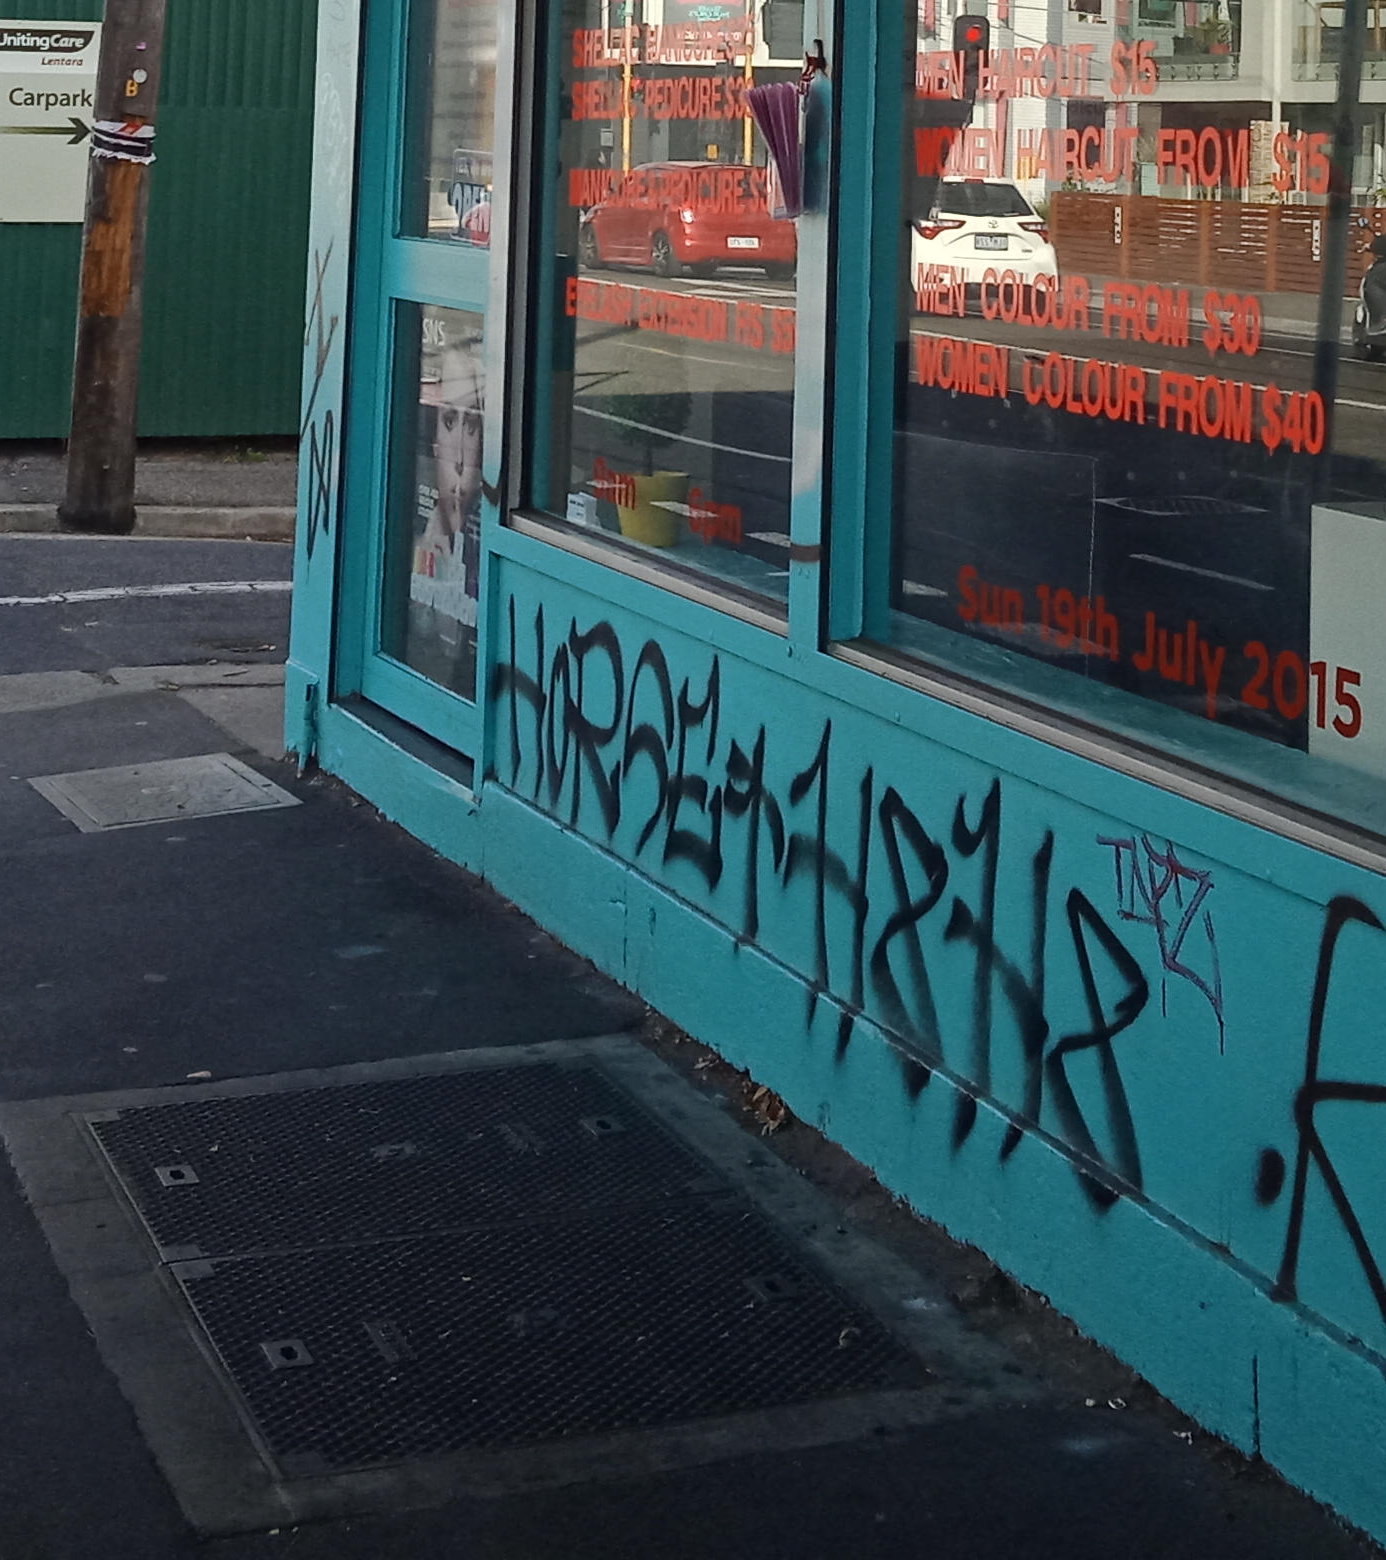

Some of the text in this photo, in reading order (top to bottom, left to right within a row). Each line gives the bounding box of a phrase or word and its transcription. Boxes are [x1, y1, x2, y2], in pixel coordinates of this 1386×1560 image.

[41, 56, 84, 67] Lentara
[125, 79, 140, 98] B
[916, 40, 1159, 101] MEN HAIRCUT $15
[9, 87, 93, 111] Carpark
[645, 76, 723, 120] PEDICURE
[914, 125, 1332, 196] WOMEN HAIRCUT FROM $15
[916, 262, 1262, 359] MEN COLOUR FROM $30
[915, 335, 1326, 457] WOMEN COLOUR FROM $40
[957, 564, 1363, 739] Sun 19th July 2015
